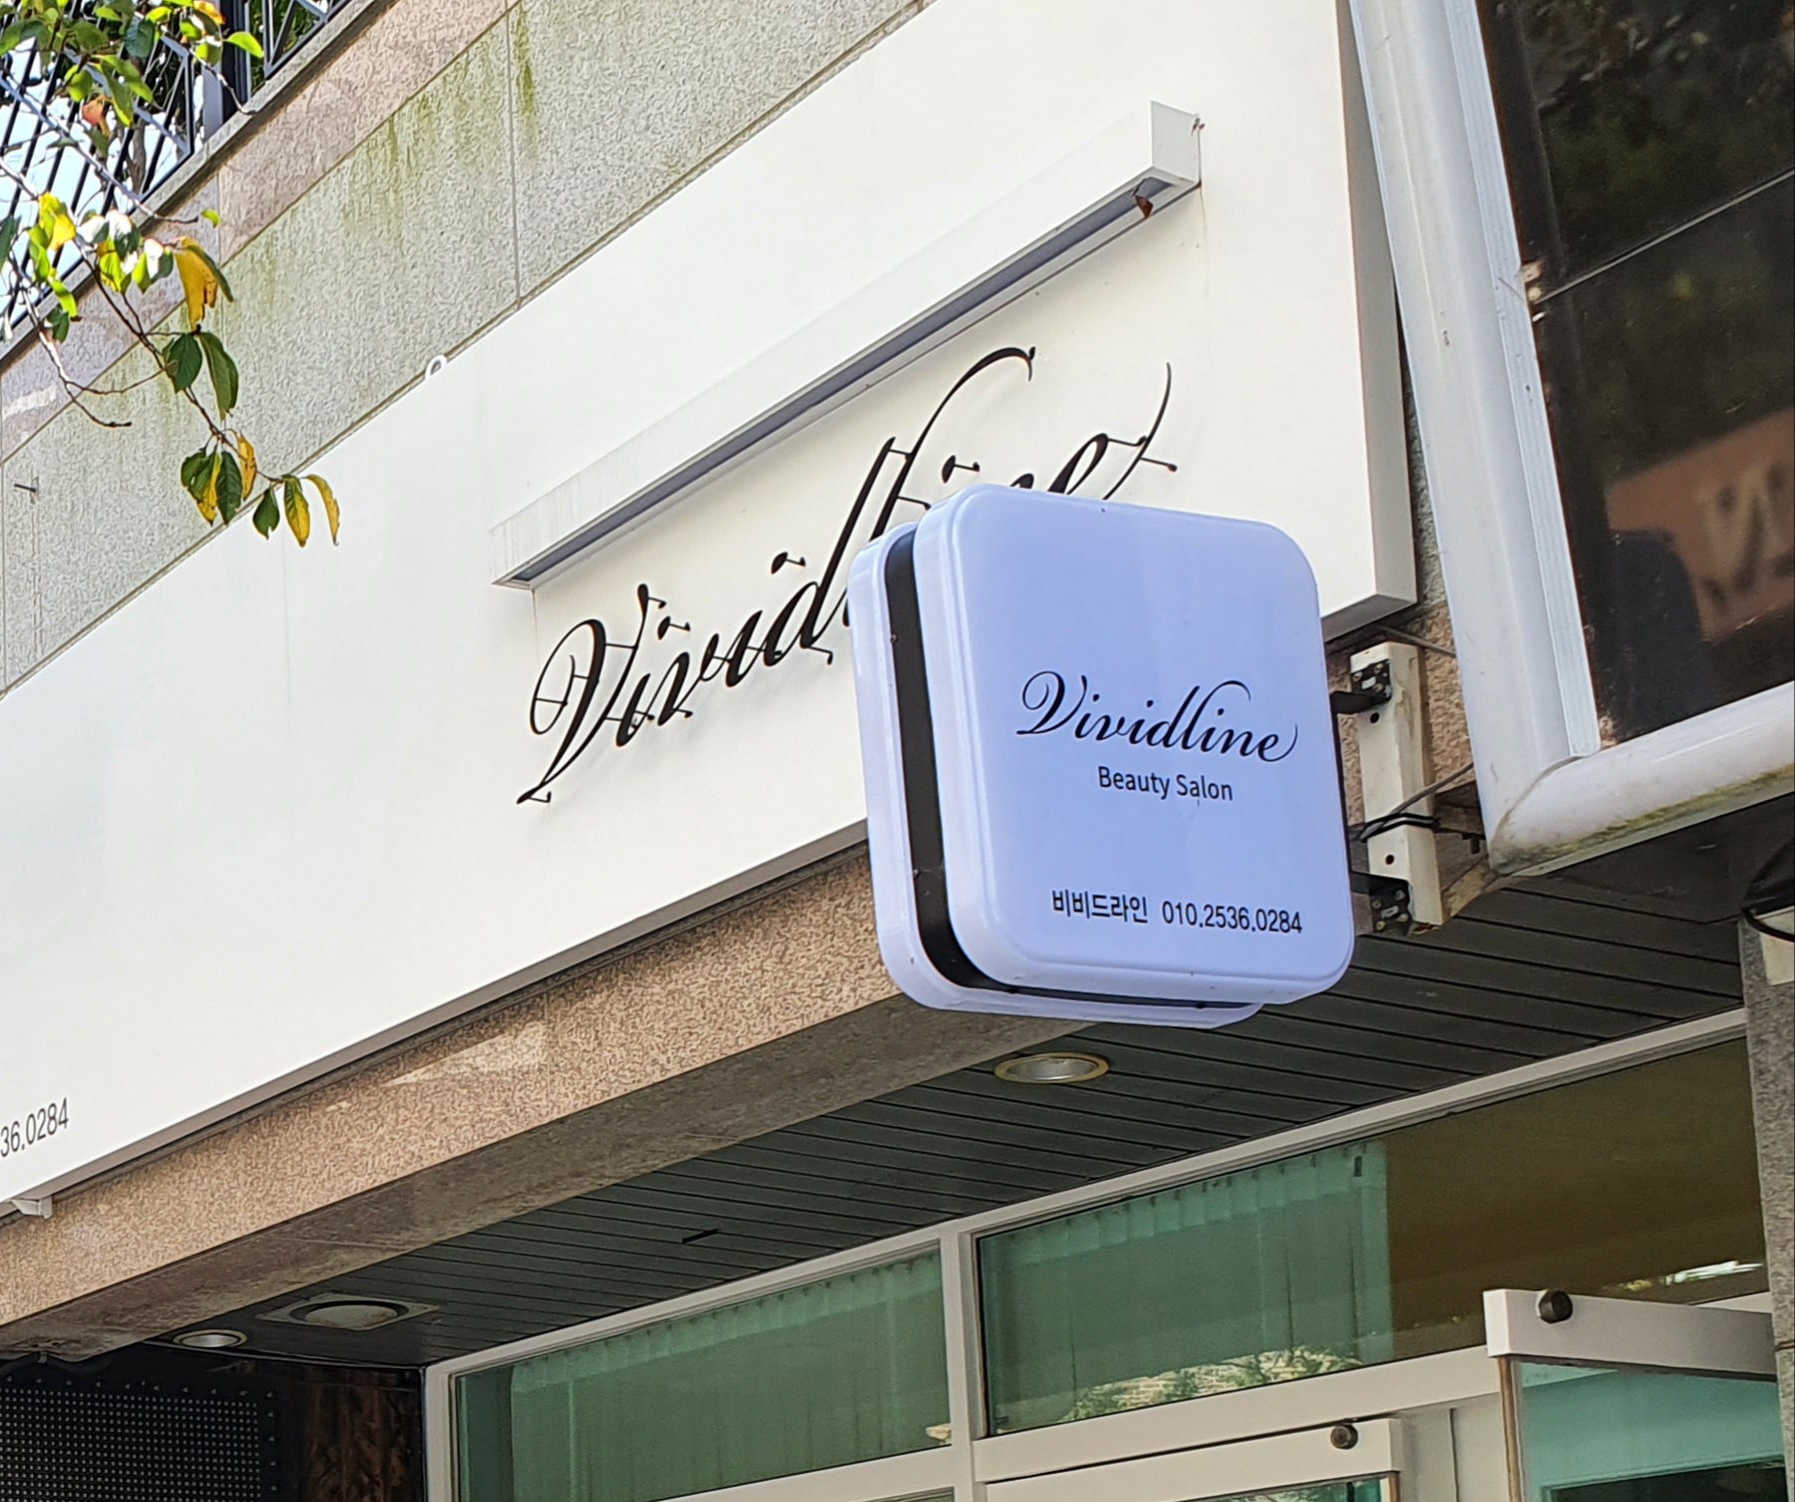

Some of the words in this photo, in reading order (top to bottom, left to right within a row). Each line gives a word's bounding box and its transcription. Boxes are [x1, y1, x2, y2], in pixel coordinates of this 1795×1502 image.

[1015, 670, 1299, 763] Vividline
[1098, 766, 1170, 800] Beauty
[1176, 774, 1234, 801] Salon
[1052, 889, 1148, 924] 비비드라인
[1161, 900, 1303, 934] 010.2536.0284
